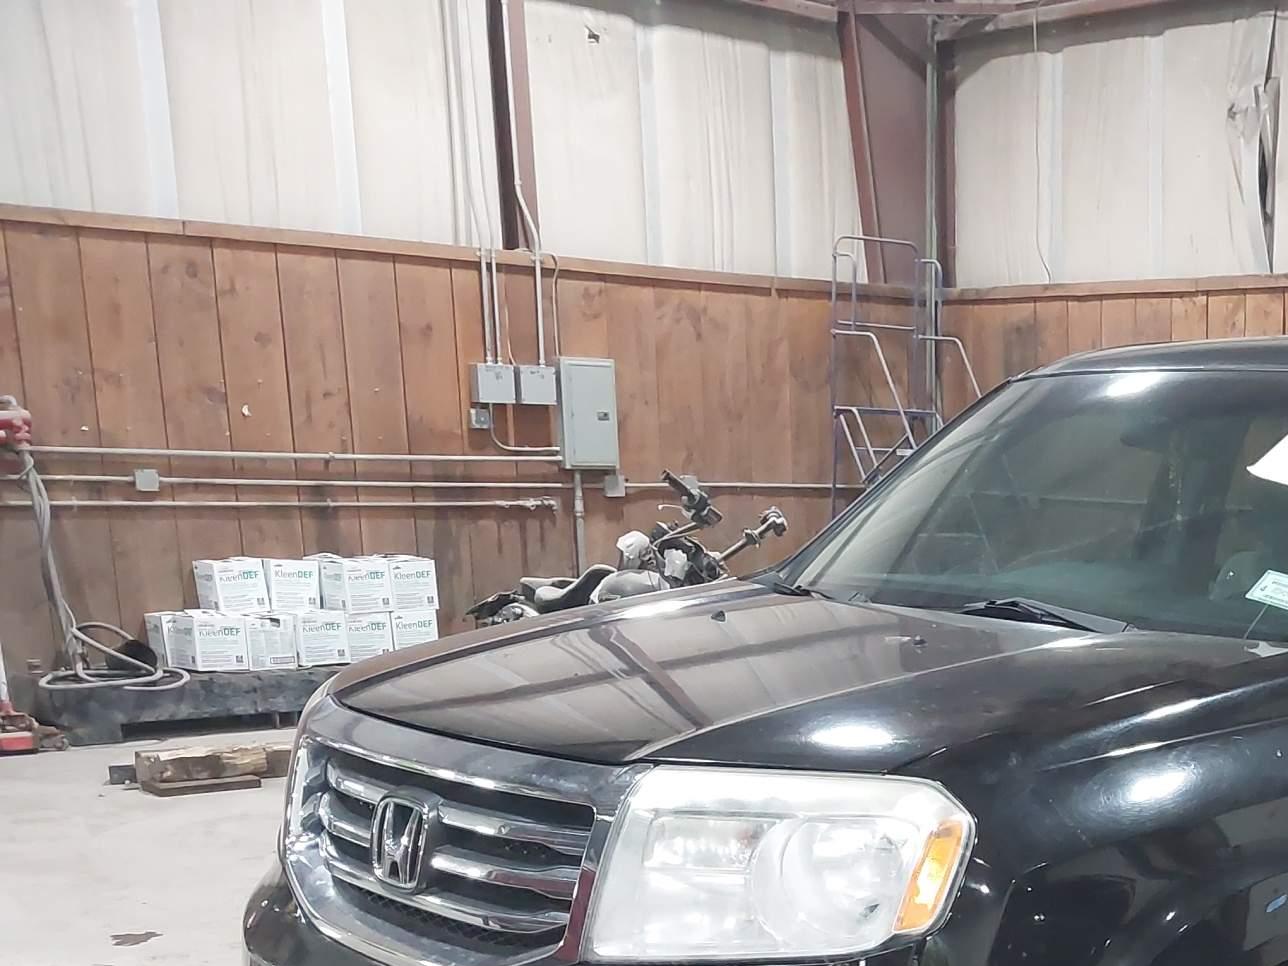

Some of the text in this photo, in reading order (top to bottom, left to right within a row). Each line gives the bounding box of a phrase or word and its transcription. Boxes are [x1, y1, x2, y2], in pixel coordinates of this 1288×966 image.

[274, 570, 313, 579] KleenDEF
[394, 570, 431, 580] KleenDEF
[396, 619, 433, 630] KleenDEF
